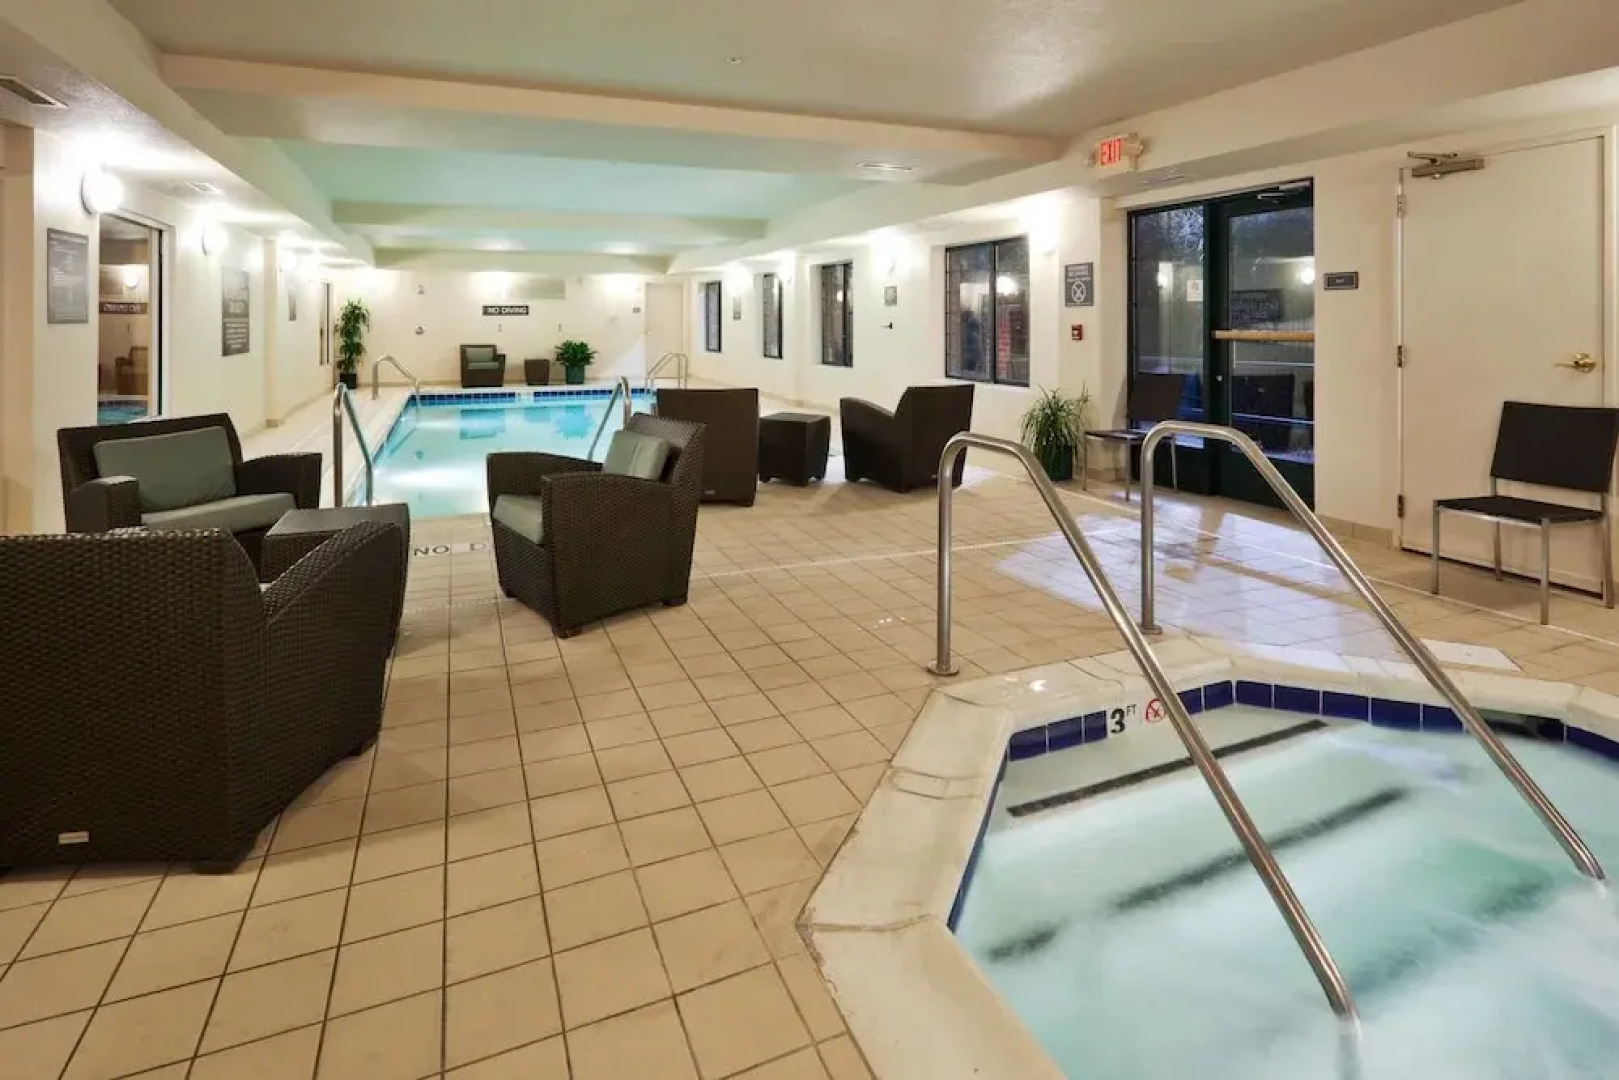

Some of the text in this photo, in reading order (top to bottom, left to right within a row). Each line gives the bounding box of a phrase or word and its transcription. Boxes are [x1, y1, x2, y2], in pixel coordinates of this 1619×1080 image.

[1100, 138, 1122, 167] EXIT
[502, 306, 527, 314] DIVING
[413, 545, 450, 556] NO
[1110, 703, 1137, 734] 3 FT
